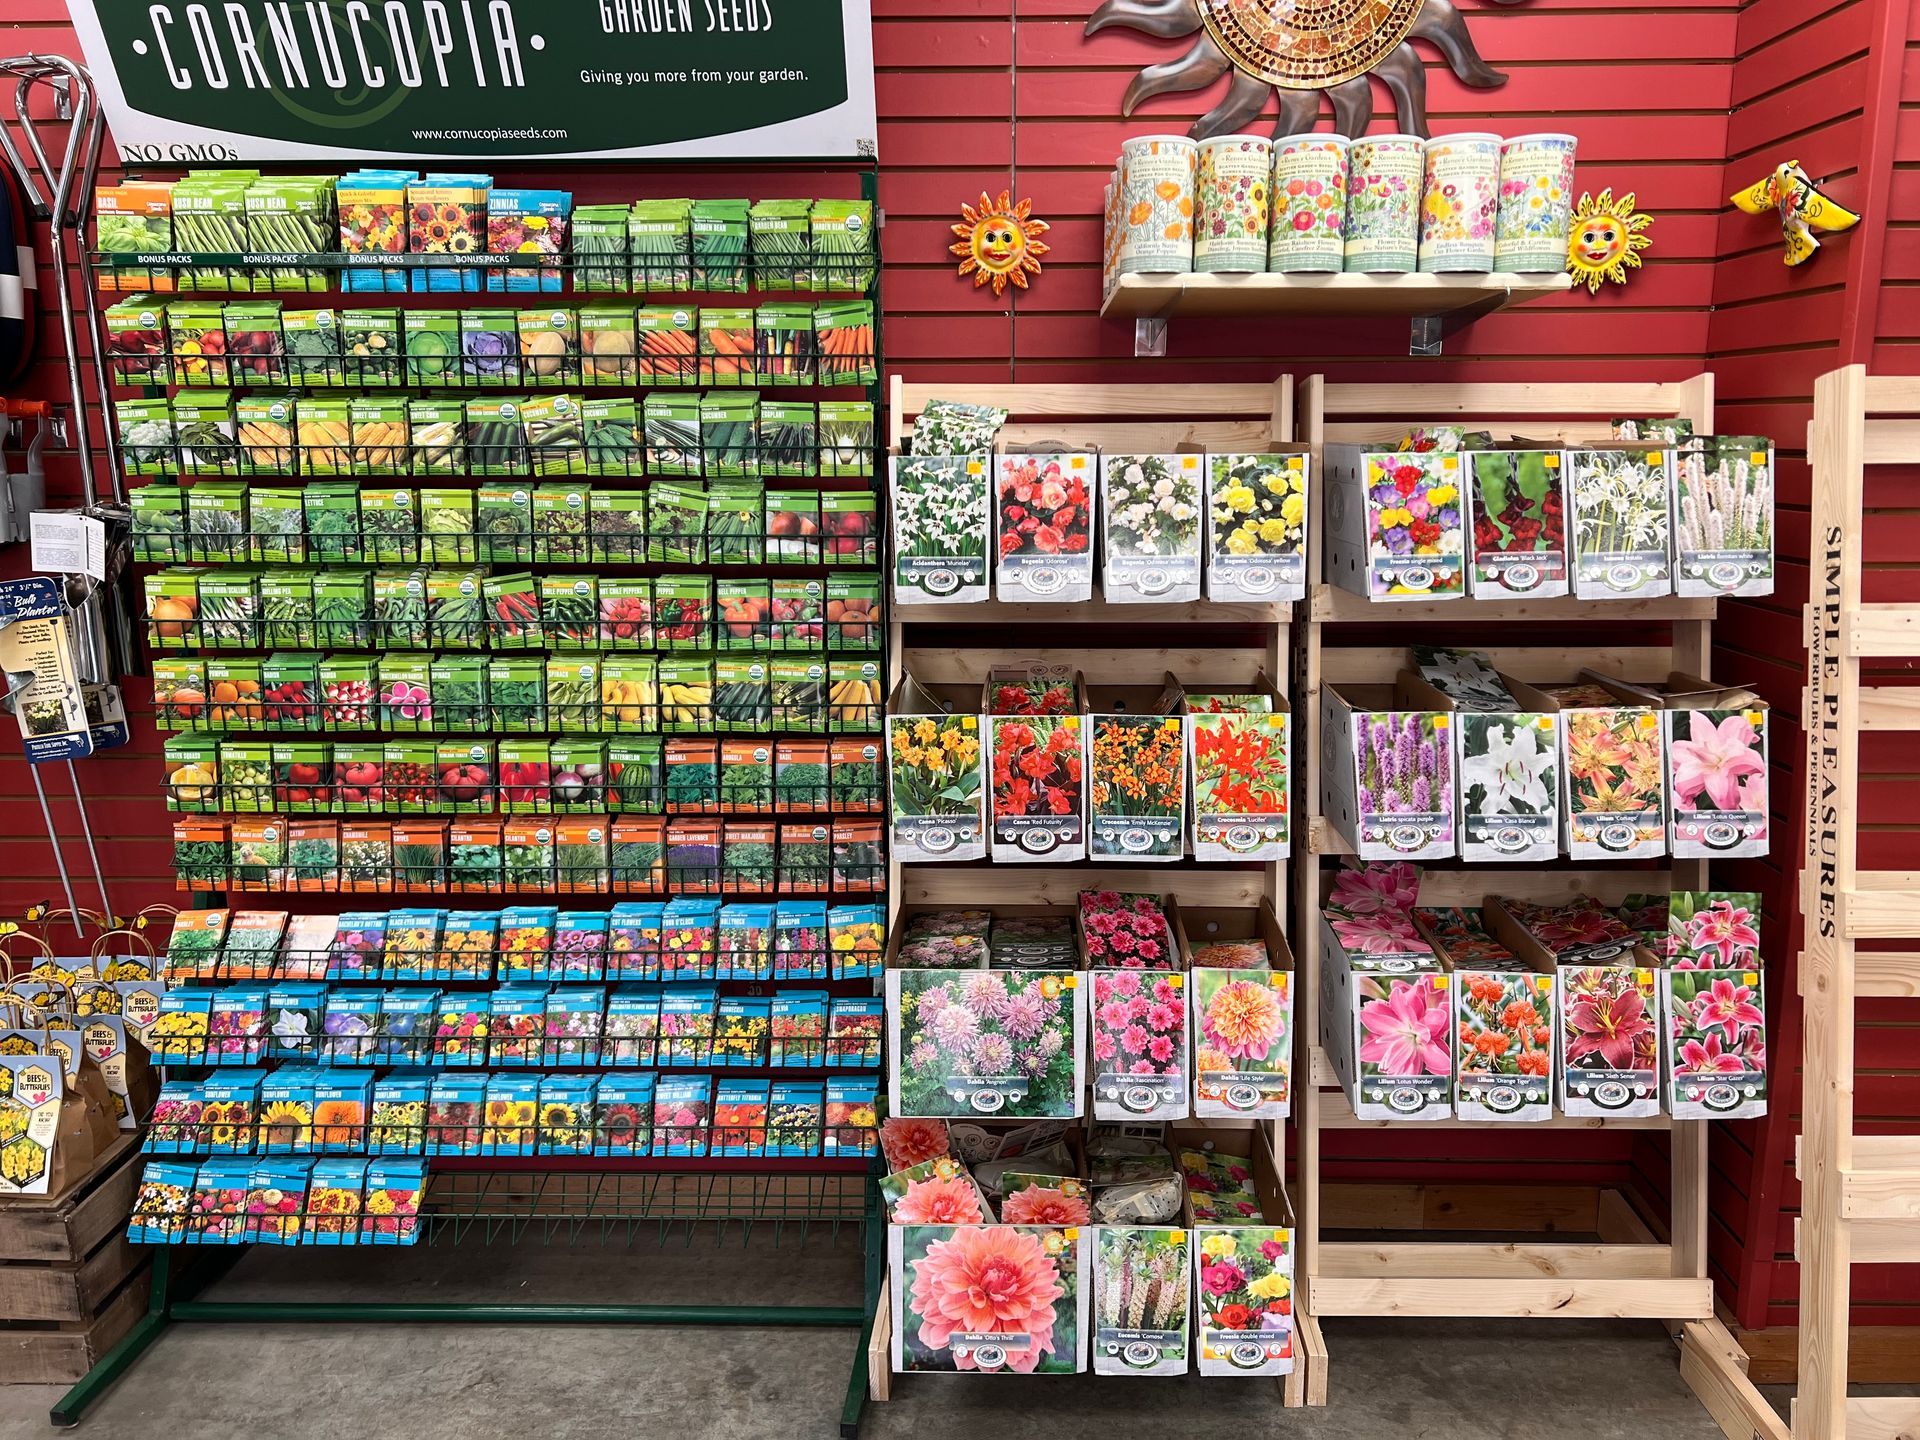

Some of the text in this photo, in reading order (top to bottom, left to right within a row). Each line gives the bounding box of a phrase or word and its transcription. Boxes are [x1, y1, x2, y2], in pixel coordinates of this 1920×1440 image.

[599, 0, 772, 33] GARDEN SEEDS
[148, 0, 525, 89] CORNUCOPIA
[580, 68, 808, 85] Giving you more from your garden.
[412, 127, 568, 141] www.cornucopiaseeds.com
[122, 142, 238, 162] NO GMOs
[490, 198, 518, 210] ZINNIAS
[138, 255, 192, 263] BONUS PACKS
[243, 255, 297, 264] BONUS PACKS
[349, 255, 404, 264] BONUS PACKS
[455, 255, 510, 263] BONUS PACKS
[519, 320, 549, 330] CANTALOUPE
[582, 319, 611, 328] CANTALOUPE
[640, 318, 658, 327] CARROT
[13, 593, 37, 608] Bulb
[17, 605, 58, 619] Planter
[1809, 606, 1821, 857] FLOWERBULBS & PERENNIALS
[1819, 525, 1842, 939] SIMPLE PLEASURES
[610, 753, 640, 762] WATERMELON
[1397, 816, 1416, 824] spicata
[1416, 815, 1434, 823] purple
[134, 997, 149, 1005] BEES
[93, 1030, 107, 1038] BEES
[26, 1074, 41, 1083] BEES
[1495, 1077, 1516, 1085] 'Orange
